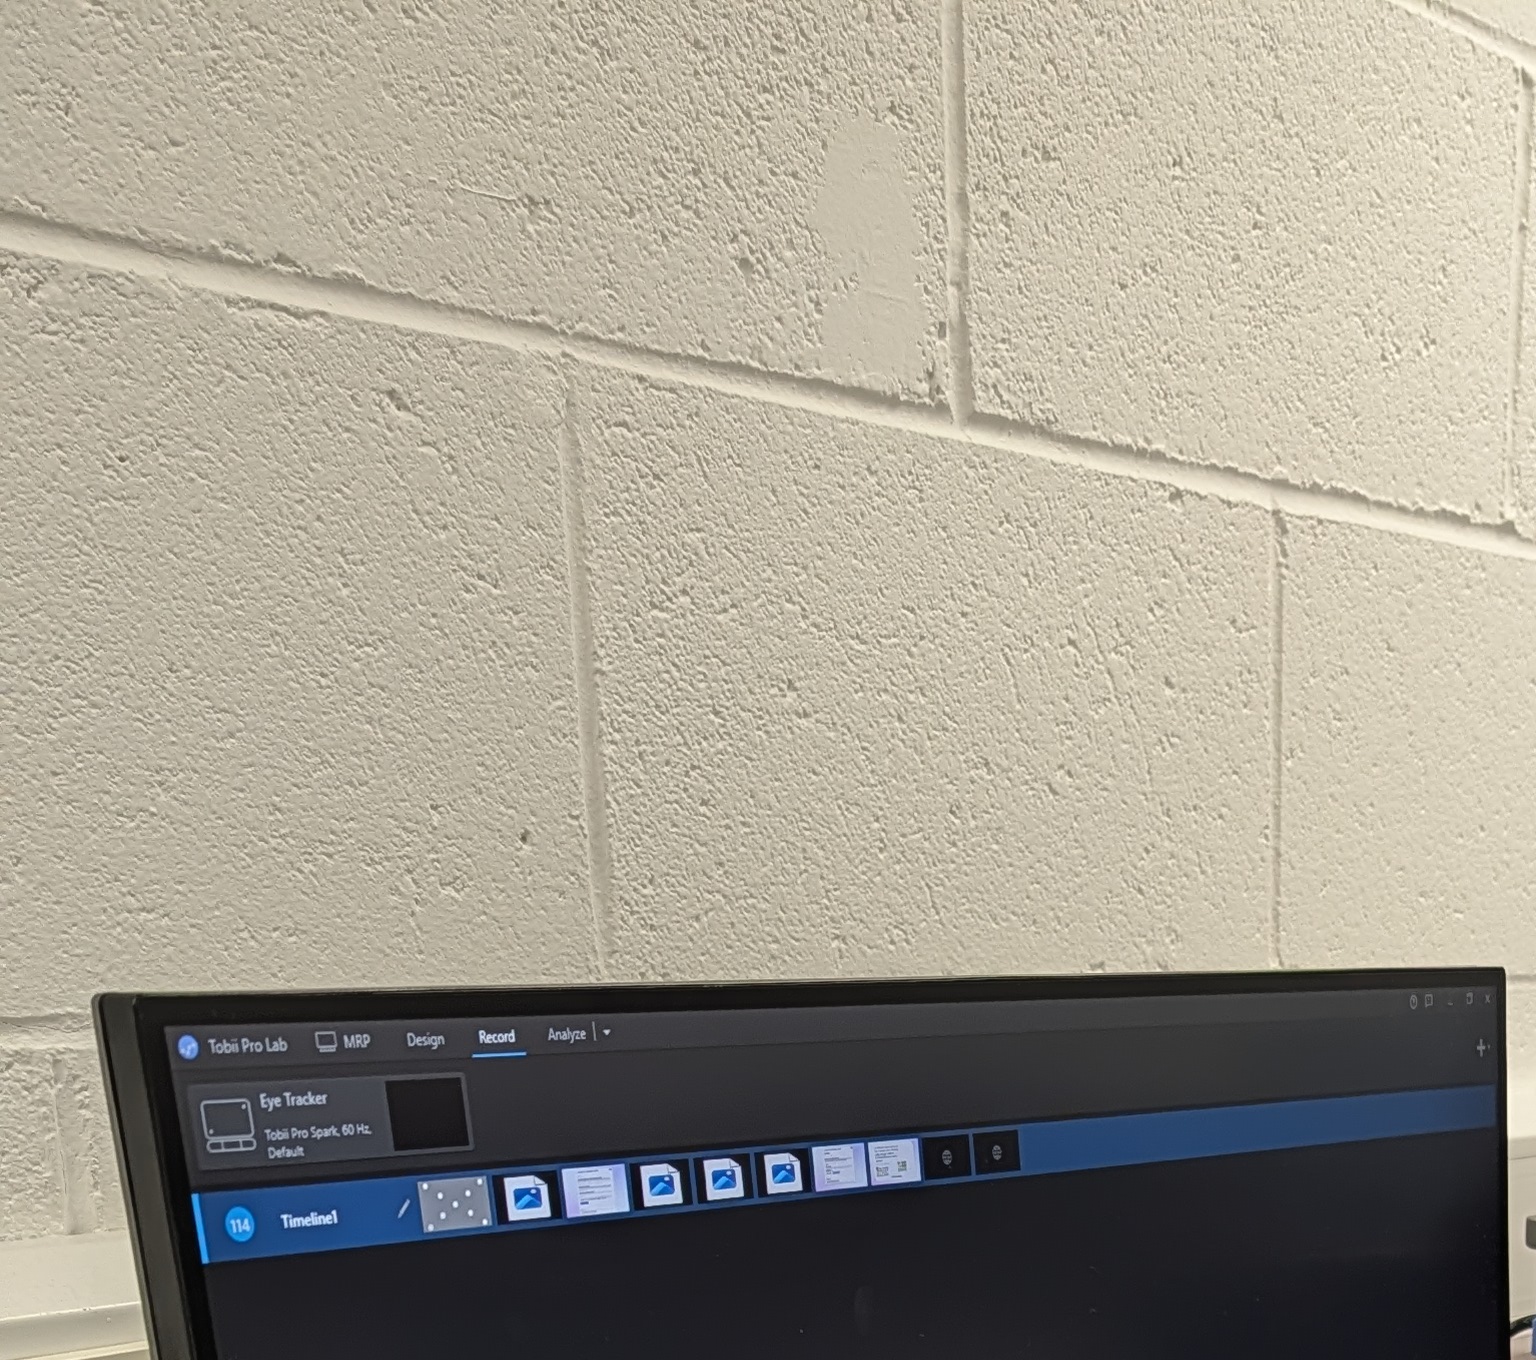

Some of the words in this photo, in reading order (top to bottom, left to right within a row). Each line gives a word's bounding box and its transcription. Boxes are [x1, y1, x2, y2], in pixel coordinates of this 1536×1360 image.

[343, 1034, 370, 1048] MRP
[407, 1031, 445, 1050] Design
[479, 1029, 515, 1045] Record
[548, 1026, 586, 1044] Analyze
[208, 1038, 238, 1054] Tobii
[241, 1038, 263, 1052] Pro
[265, 1037, 288, 1051] Lab
[260, 1093, 281, 1112] Eye
[284, 1091, 327, 1106] Tracker
[264, 1128, 289, 1141] Tobii
[291, 1127, 308, 1139] Pro
[342, 1124, 354, 1135] 60
[268, 1147, 304, 1159] Default
[229, 1217, 250, 1234] 114
[280, 1210, 338, 1229] Timeline1
